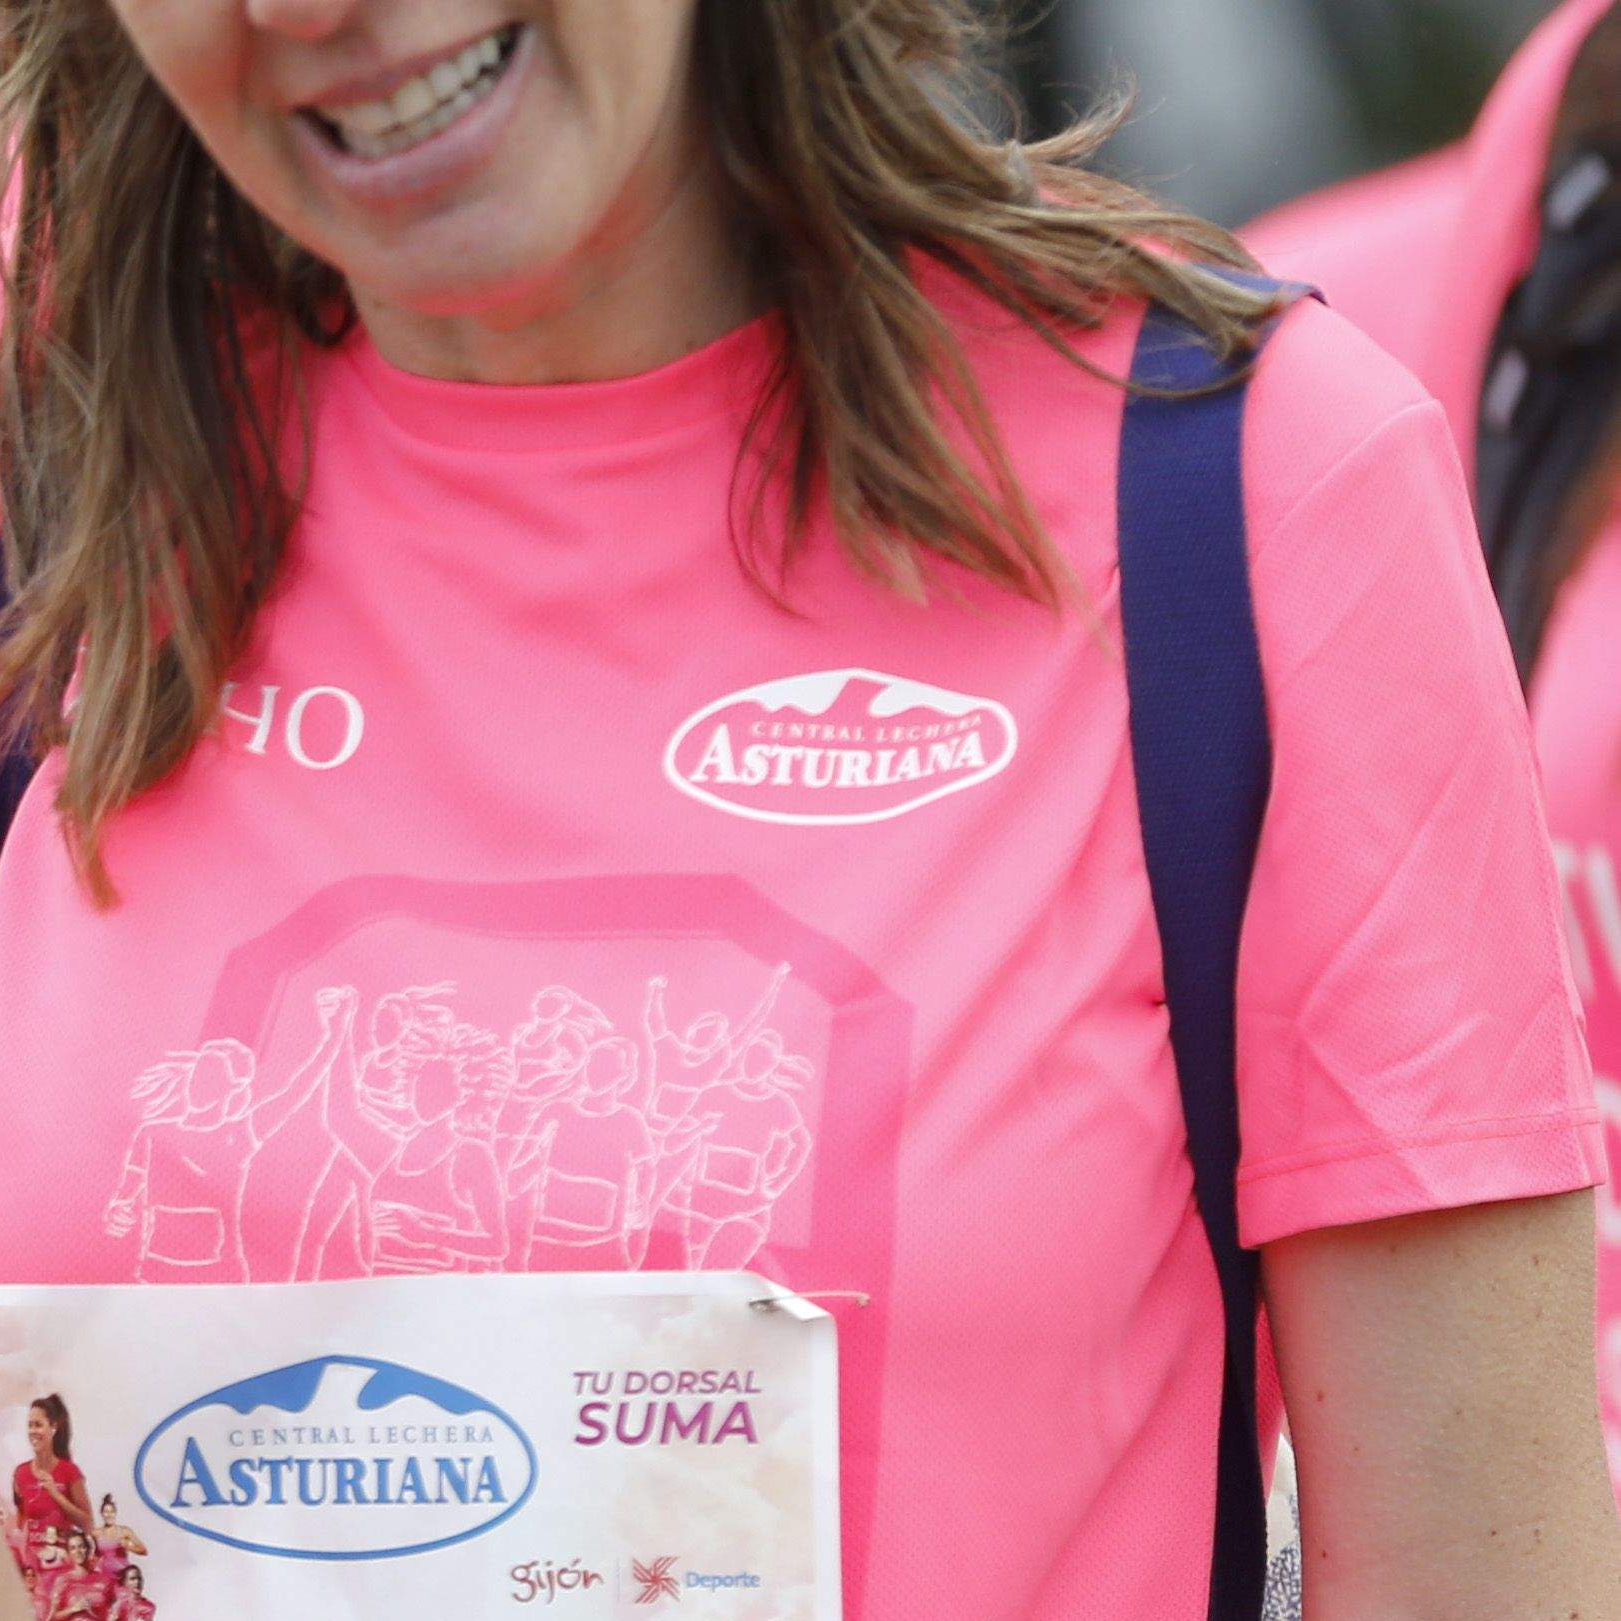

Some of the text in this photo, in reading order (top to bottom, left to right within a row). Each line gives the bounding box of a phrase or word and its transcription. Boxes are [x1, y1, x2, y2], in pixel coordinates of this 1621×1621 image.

[751, 715, 982, 741] CENTRAL LECHERA
[689, 723, 988, 788] ASTURIANA
[573, 1370, 762, 1396] TU DORSAL
[229, 1426, 494, 1446] CENTRAL LECHERA
[574, 1401, 759, 1446] SUMA
[170, 1437, 508, 1507] ASTURIANA
[686, 1571, 761, 1593] Deporte
